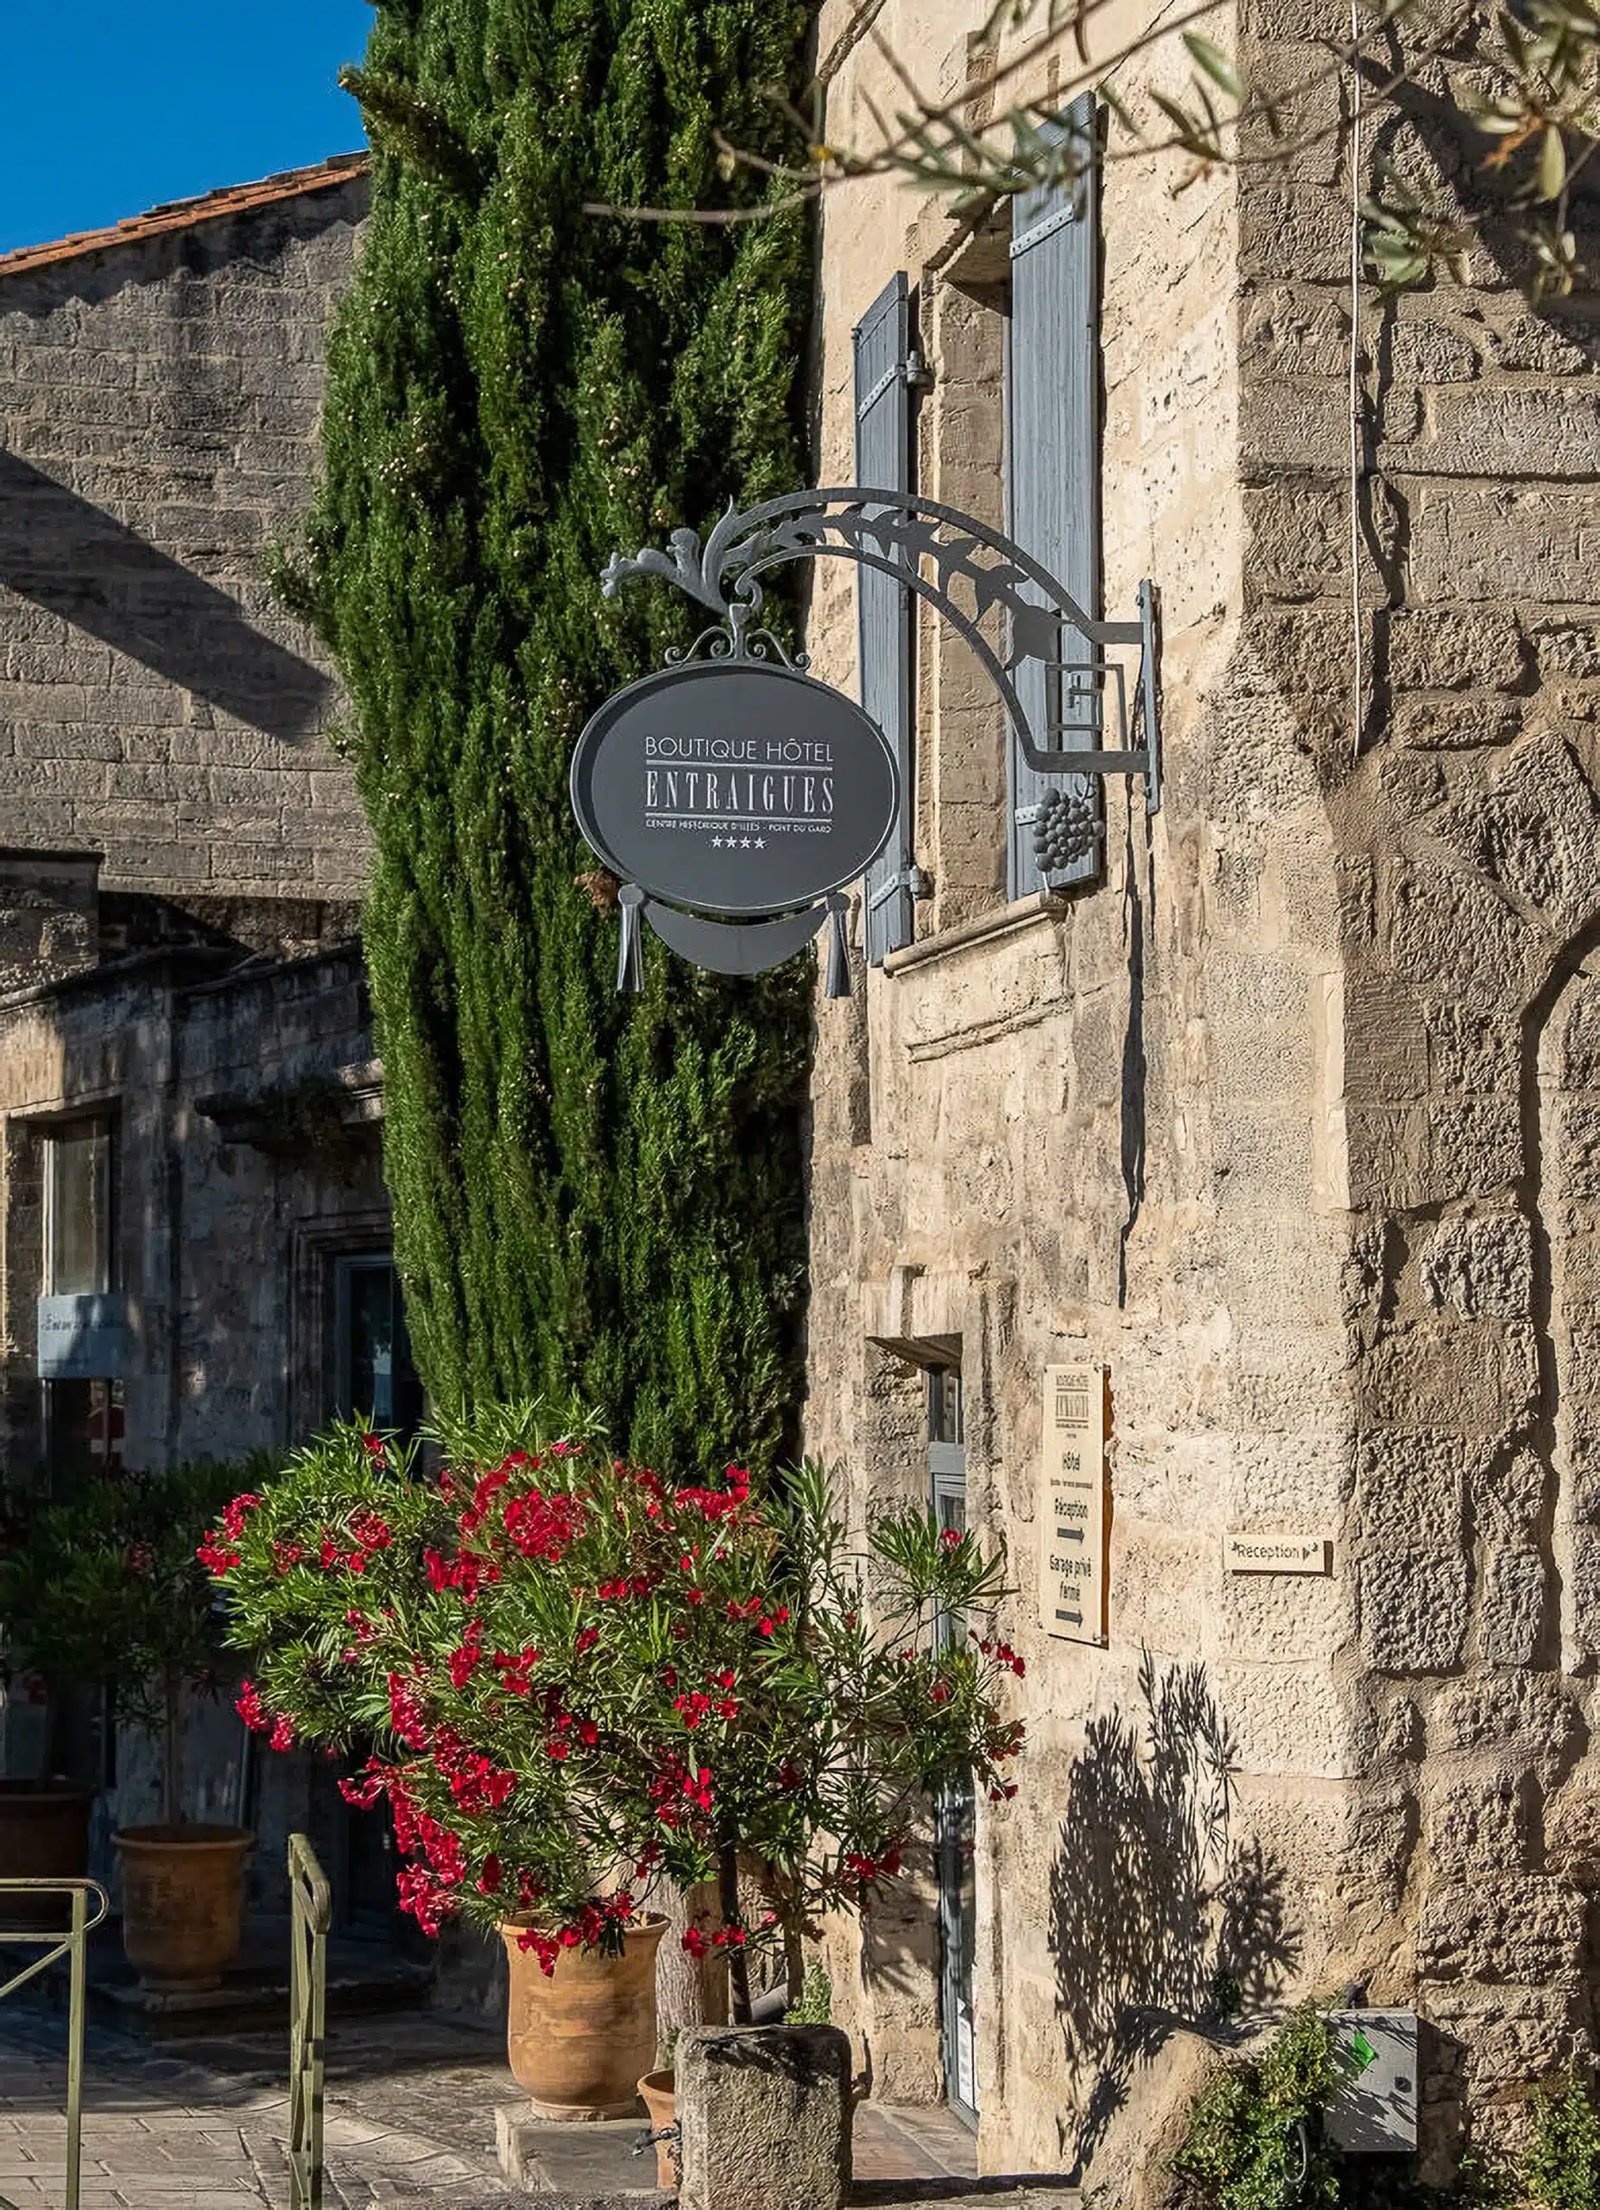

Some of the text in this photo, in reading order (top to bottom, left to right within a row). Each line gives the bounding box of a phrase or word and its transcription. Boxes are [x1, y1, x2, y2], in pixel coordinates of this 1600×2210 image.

[645, 736, 834, 763] BOUTIQUE HÔTEL
[645, 770, 834, 814] ENTRAIGUES
[1050, 1554, 1073, 1578] Garage
